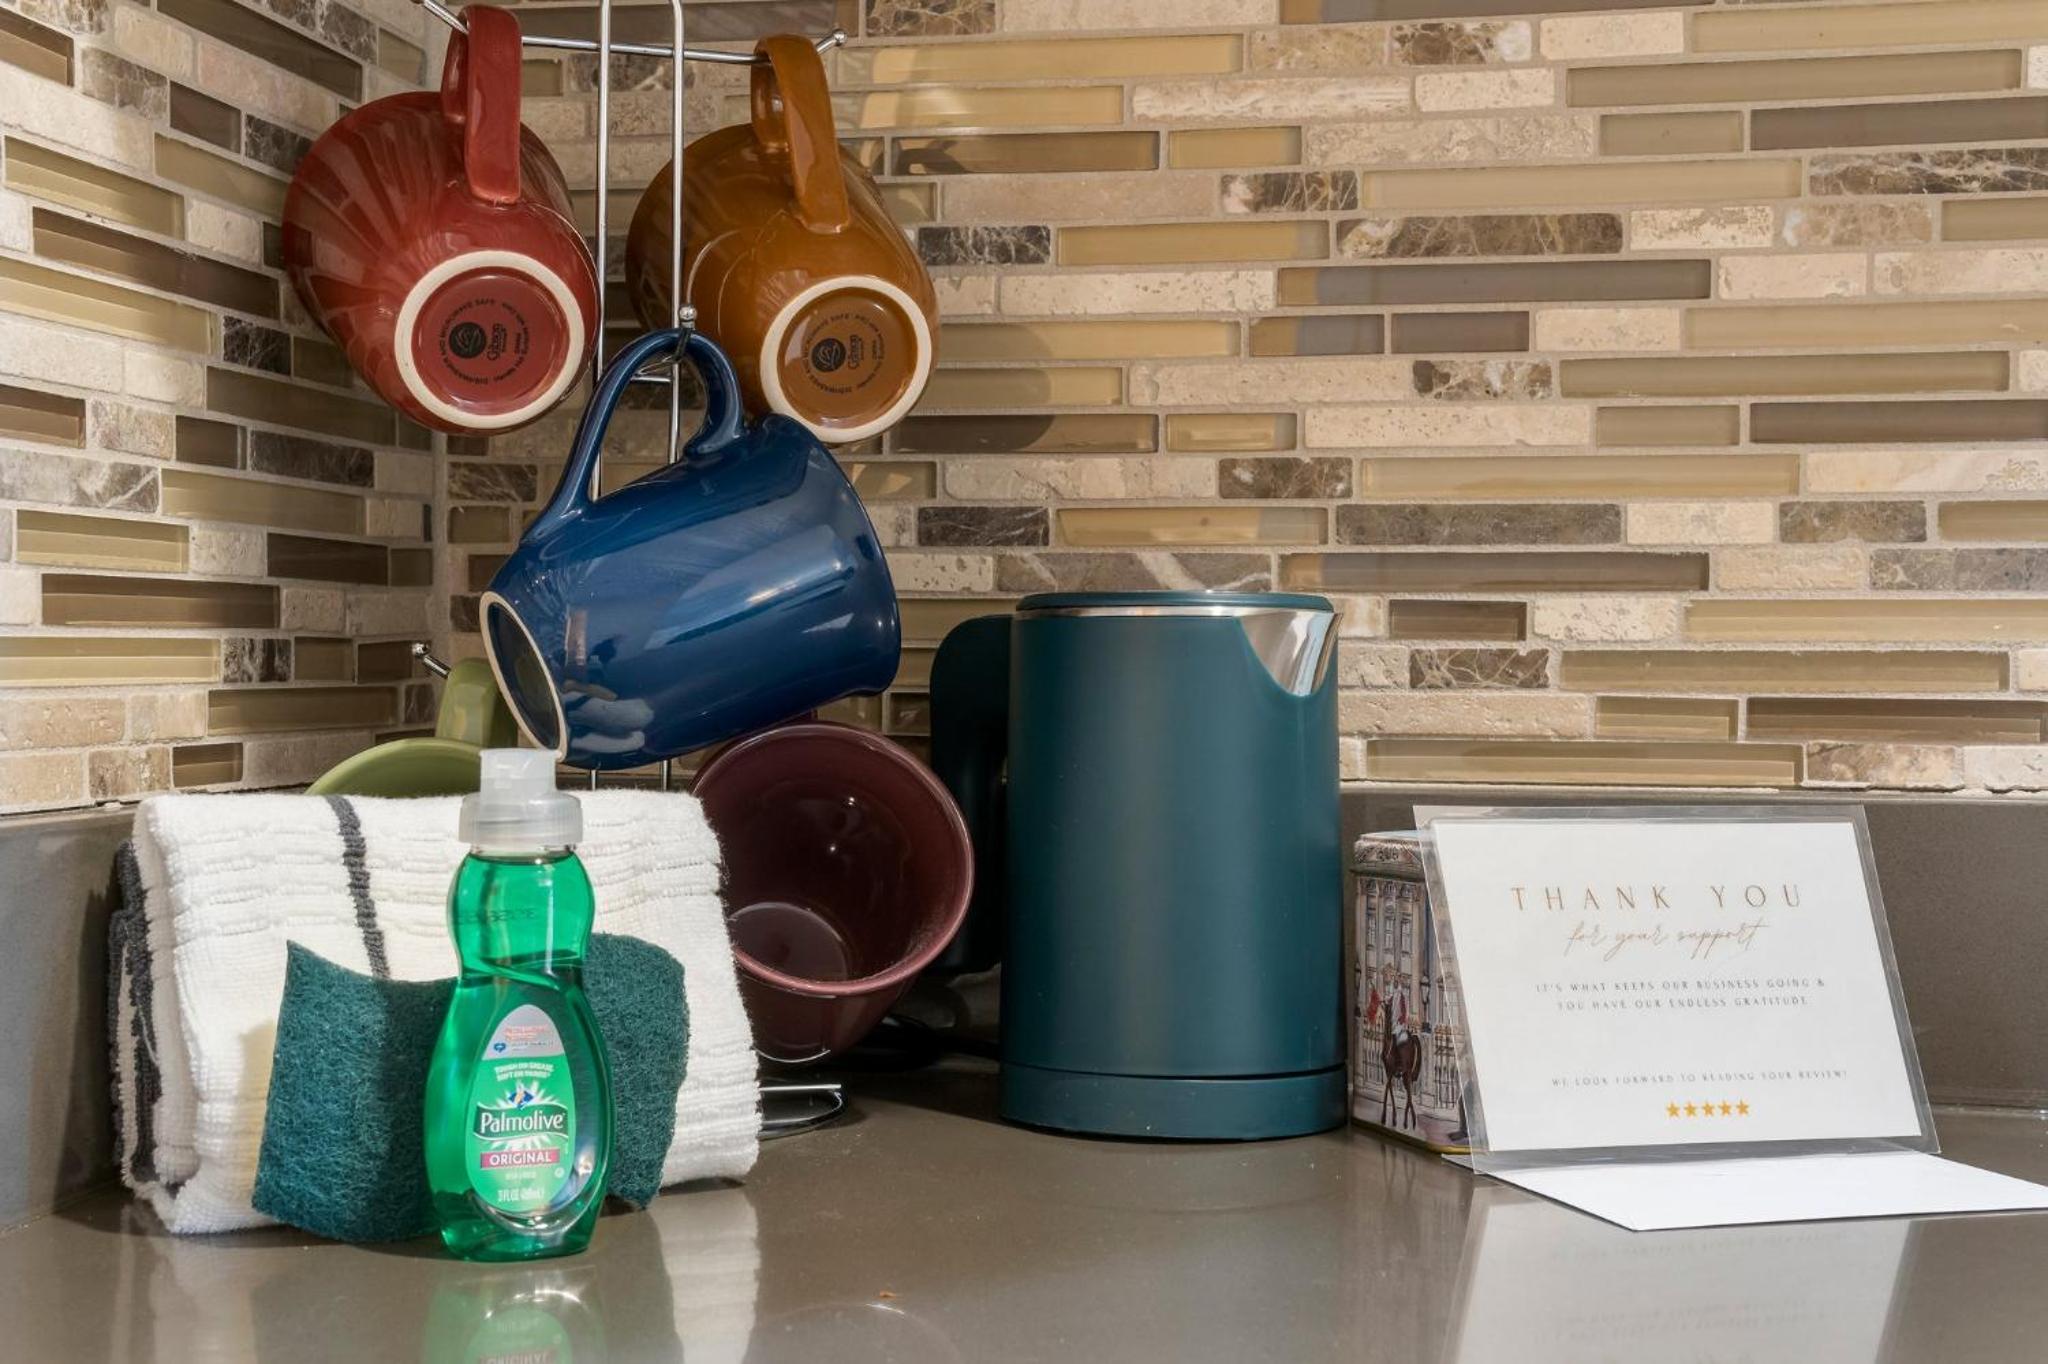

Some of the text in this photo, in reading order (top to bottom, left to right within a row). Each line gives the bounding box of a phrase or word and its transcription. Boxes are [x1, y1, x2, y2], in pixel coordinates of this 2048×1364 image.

[1510, 883, 1800, 911] THANK YOU
[1563, 916, 1770, 962] for your support
[1569, 982, 1606, 993] WHAT
[1614, 981, 1655, 992] KEEPS
[1661, 980, 1688, 991] OUR
[1696, 979, 1759, 990] BUSINESS
[1767, 977, 1809, 989] GOING
[1558, 996, 1808, 1011] YOU HAVE OUR ENDLESS GRATITUDE
[480, 1109, 563, 1134] Palmolive
[489, 1151, 552, 1166] ORIGINAL
